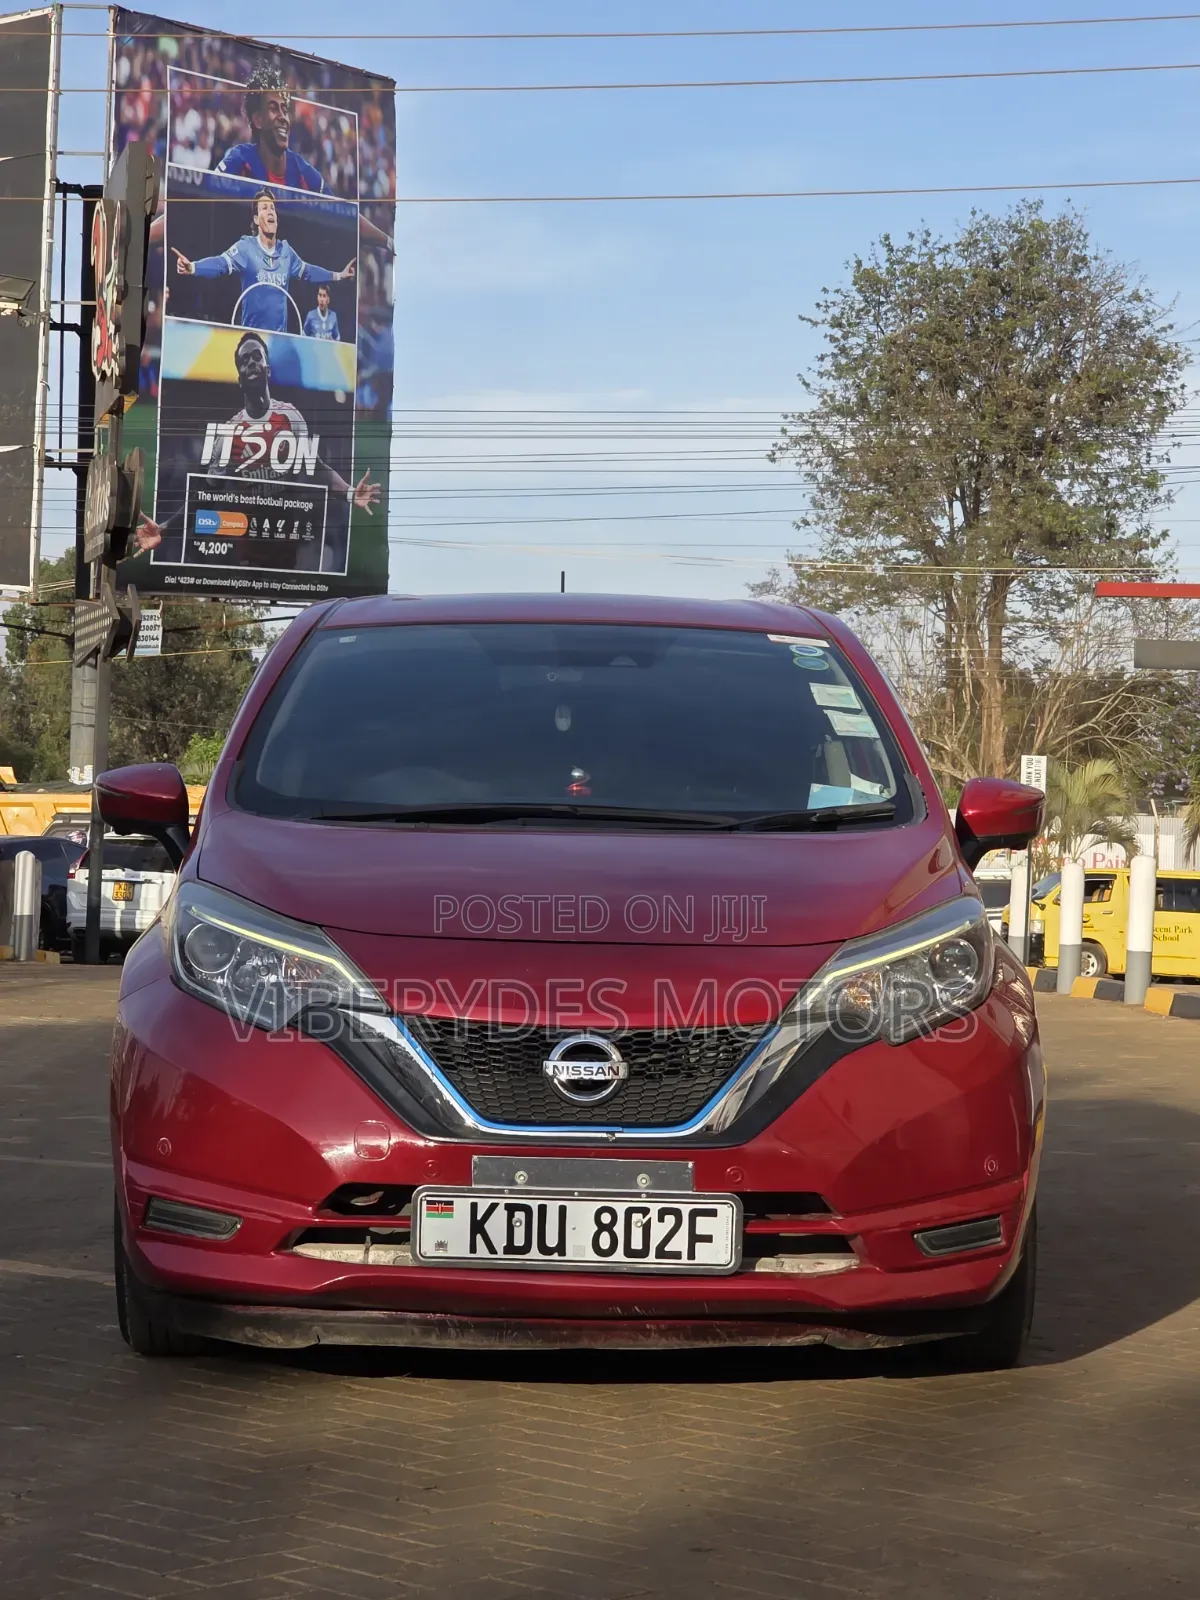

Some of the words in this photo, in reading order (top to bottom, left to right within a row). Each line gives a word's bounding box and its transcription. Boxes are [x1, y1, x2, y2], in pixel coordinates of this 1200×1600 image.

[270, 430, 320, 476] ON
[197, 490, 212, 501] The
[212, 493, 239, 503] world's
[240, 494, 256, 505] best
[256, 495, 283, 507] football
[284, 499, 314, 512] package
[222, 520, 244, 529] Compact
[198, 541, 228, 555] 4,200
[164, 575, 177, 584] Dial
[203, 577, 231, 586] Download
[252, 580, 263, 590] App
[263, 581, 269, 589] to
[270, 581, 281, 592] stay
[281, 582, 310, 591] Connected
[310, 583, 316, 591] to
[1026, 757, 1034, 769] YOU
[1034, 769, 1042, 783] NEXT
[1174, 926, 1193, 934] Park
[1152, 934, 1180, 942] School
[552, 1064, 620, 1077] NISSAN
[469, 1201, 567, 1257] KDU
[591, 1205, 718, 1261] 802F
